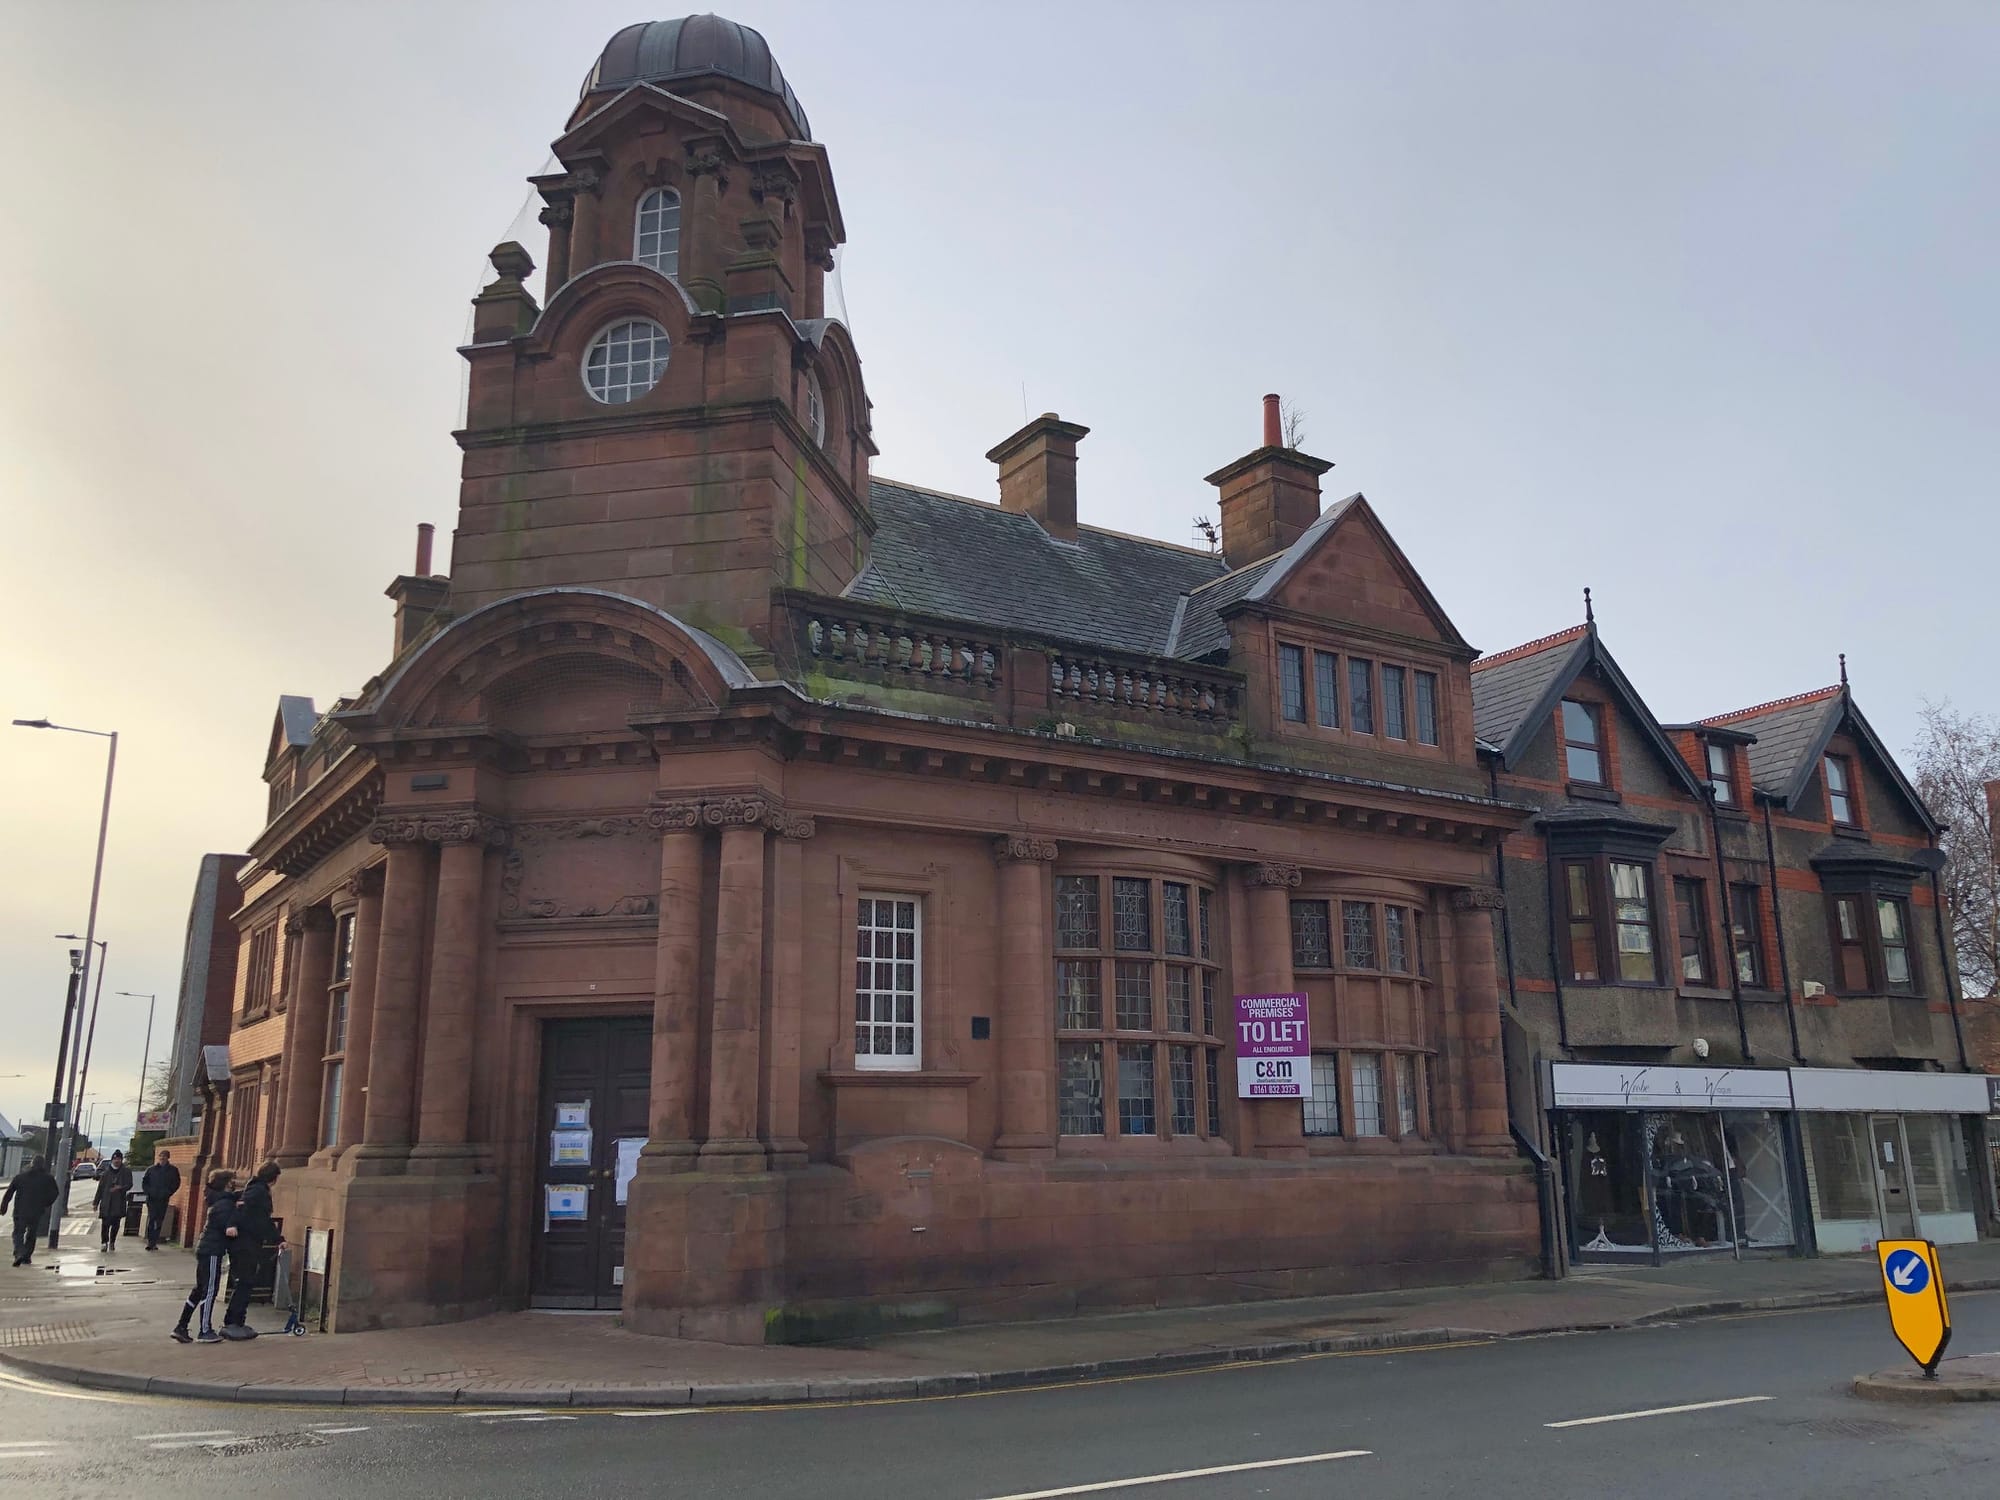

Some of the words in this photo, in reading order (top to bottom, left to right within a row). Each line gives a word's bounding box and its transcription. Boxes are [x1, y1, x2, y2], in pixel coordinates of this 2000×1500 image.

[1241, 998, 1301, 1009] COMMERCIAL
[1249, 1008, 1293, 1018] PREMISES
[1239, 1022, 1265, 1042] TO
[1271, 1021, 1304, 1042] LET
[1256, 1060, 1292, 1077] c&m
[1253, 1085, 1267, 1094] 0161
